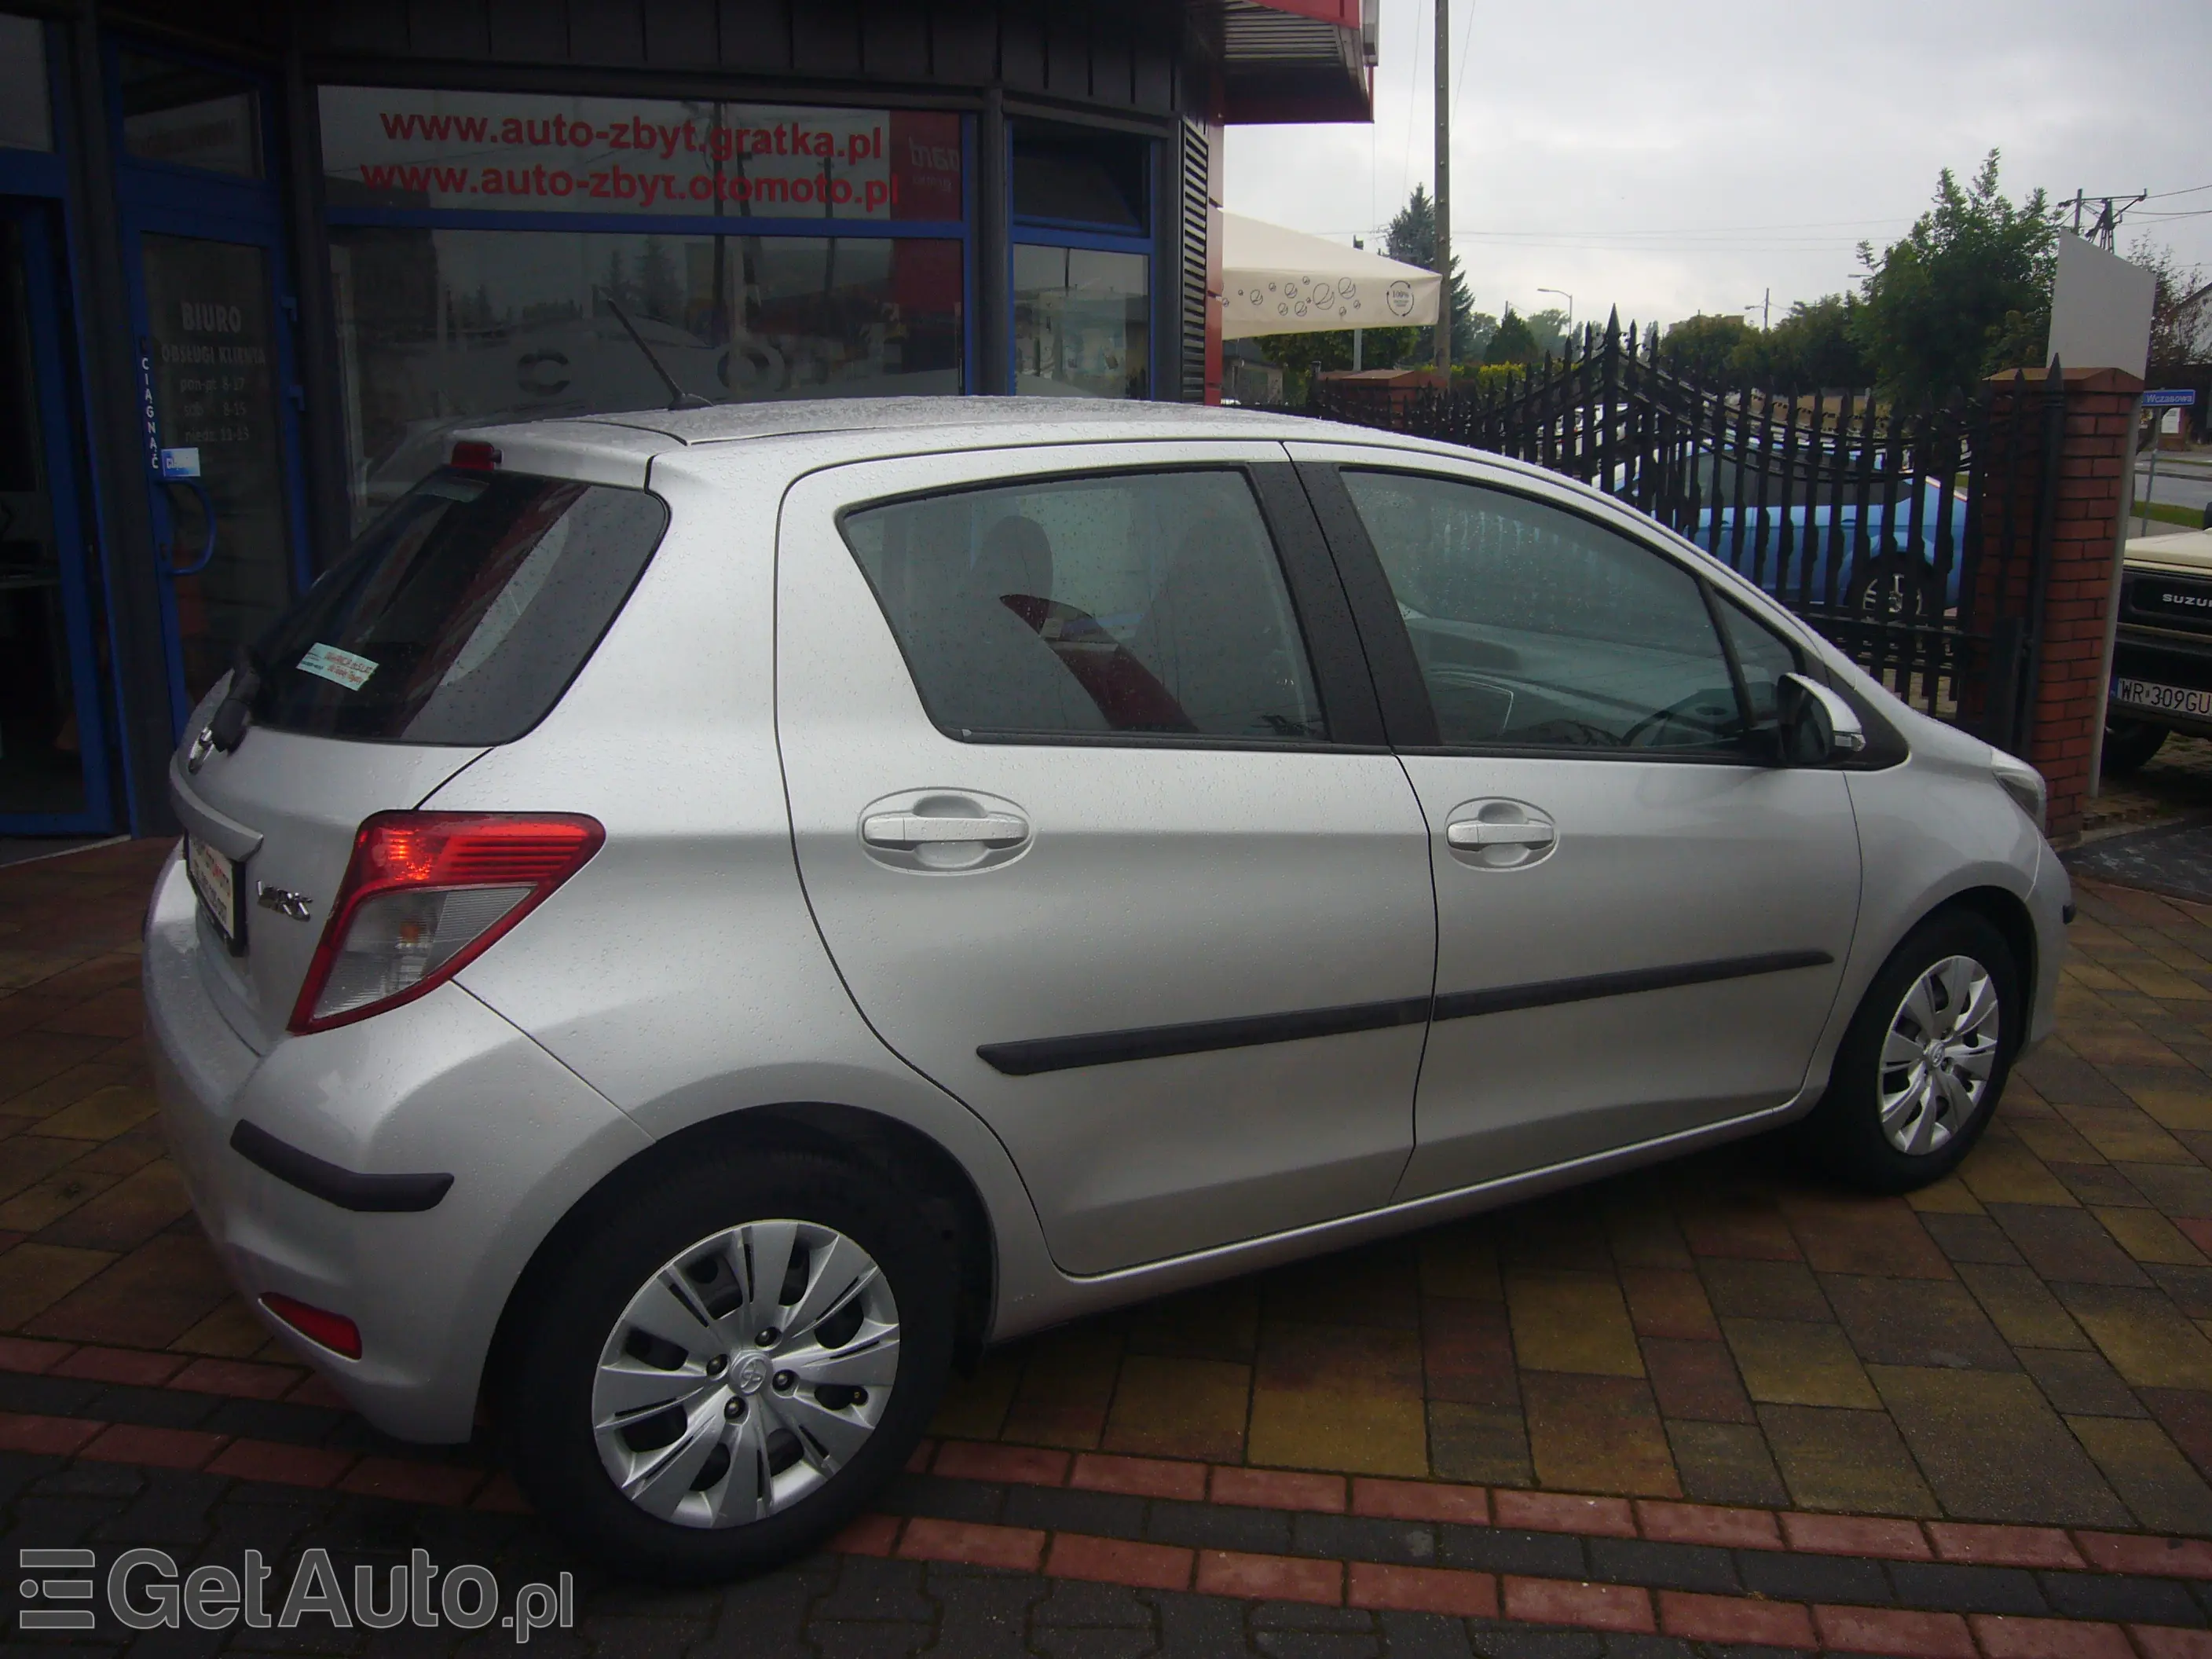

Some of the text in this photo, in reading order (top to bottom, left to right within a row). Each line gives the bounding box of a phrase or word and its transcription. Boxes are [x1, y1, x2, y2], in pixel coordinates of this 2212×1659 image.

[380, 113, 881, 159] www.auto-zbyt.gratka.pl
[361, 164, 899, 212] www.auto-zbyt.otomoto.pl
[181, 302, 241, 332] BIURO
[2162, 593, 2212, 608] SUZU
[2122, 680, 2210, 713] WR 309GU
